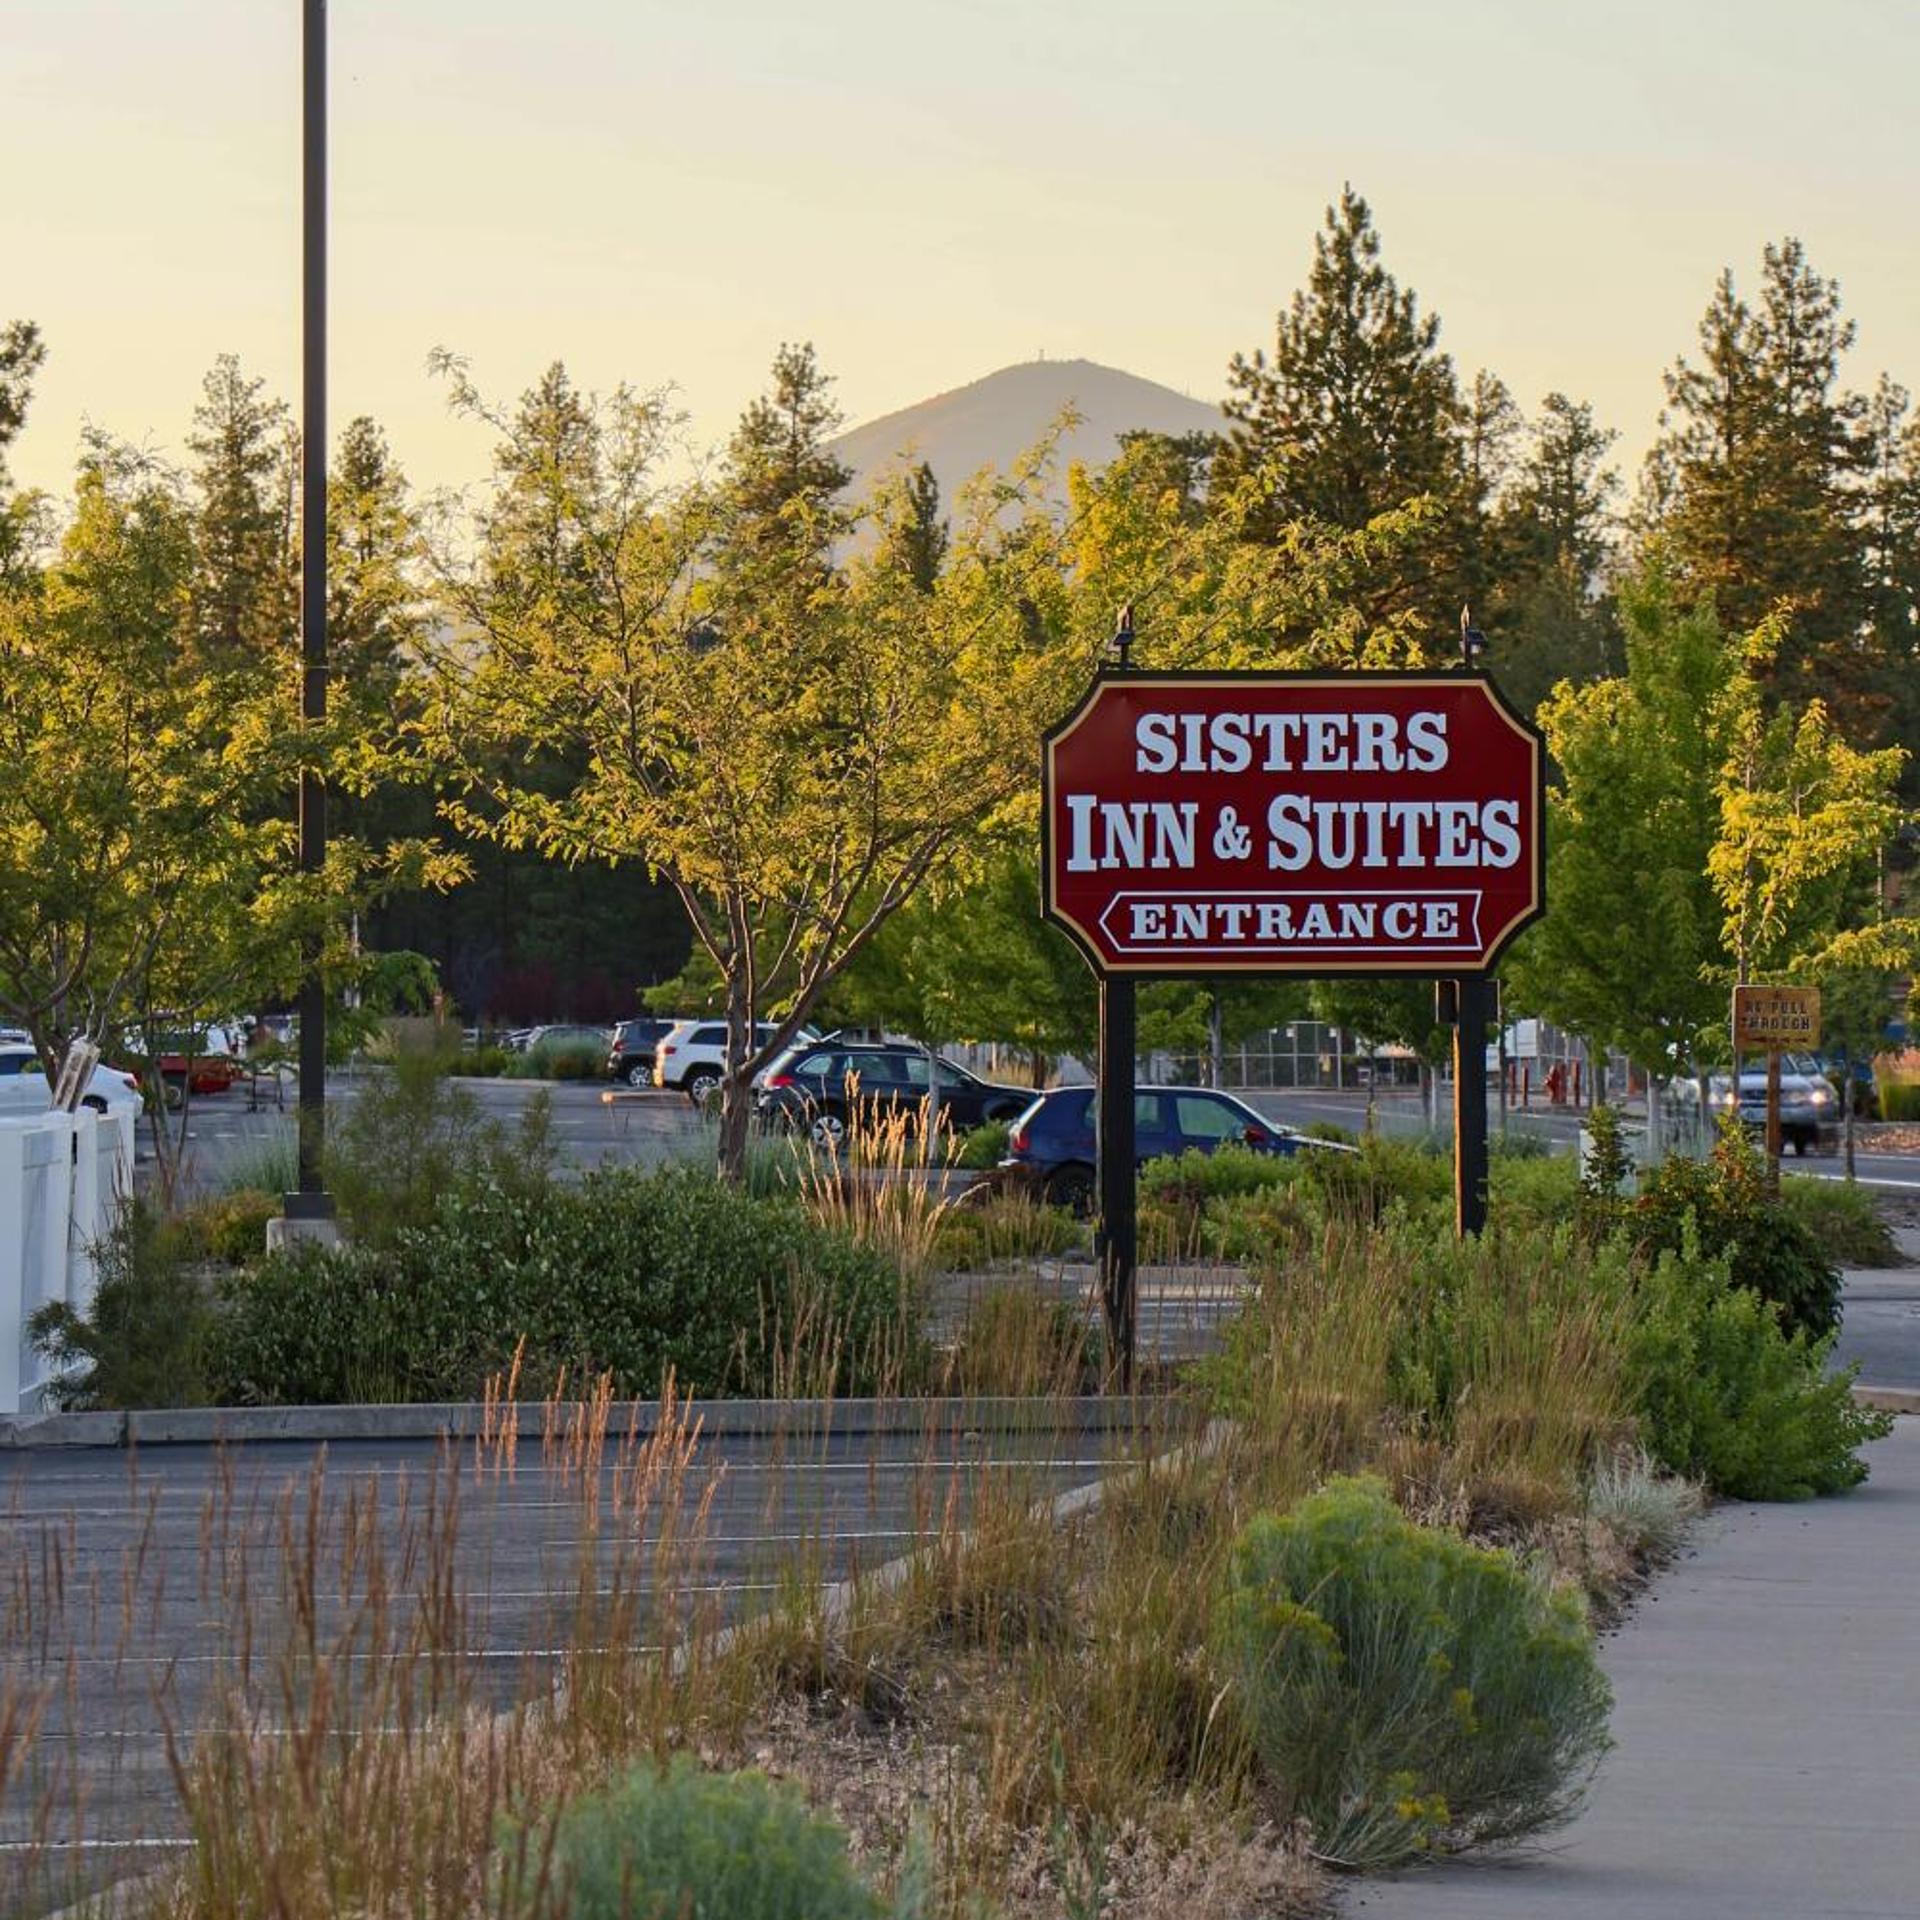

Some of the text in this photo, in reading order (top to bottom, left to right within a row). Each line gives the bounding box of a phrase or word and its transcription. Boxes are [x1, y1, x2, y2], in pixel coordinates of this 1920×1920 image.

[1135, 711, 1449, 774] SISTERS
[1066, 793, 1522, 872] INN & SUITES
[1129, 902, 1459, 940] ENTRANCE
[1741, 1016, 1810, 1030] THROUGH
[1771, 1001, 1808, 1014] PULL
